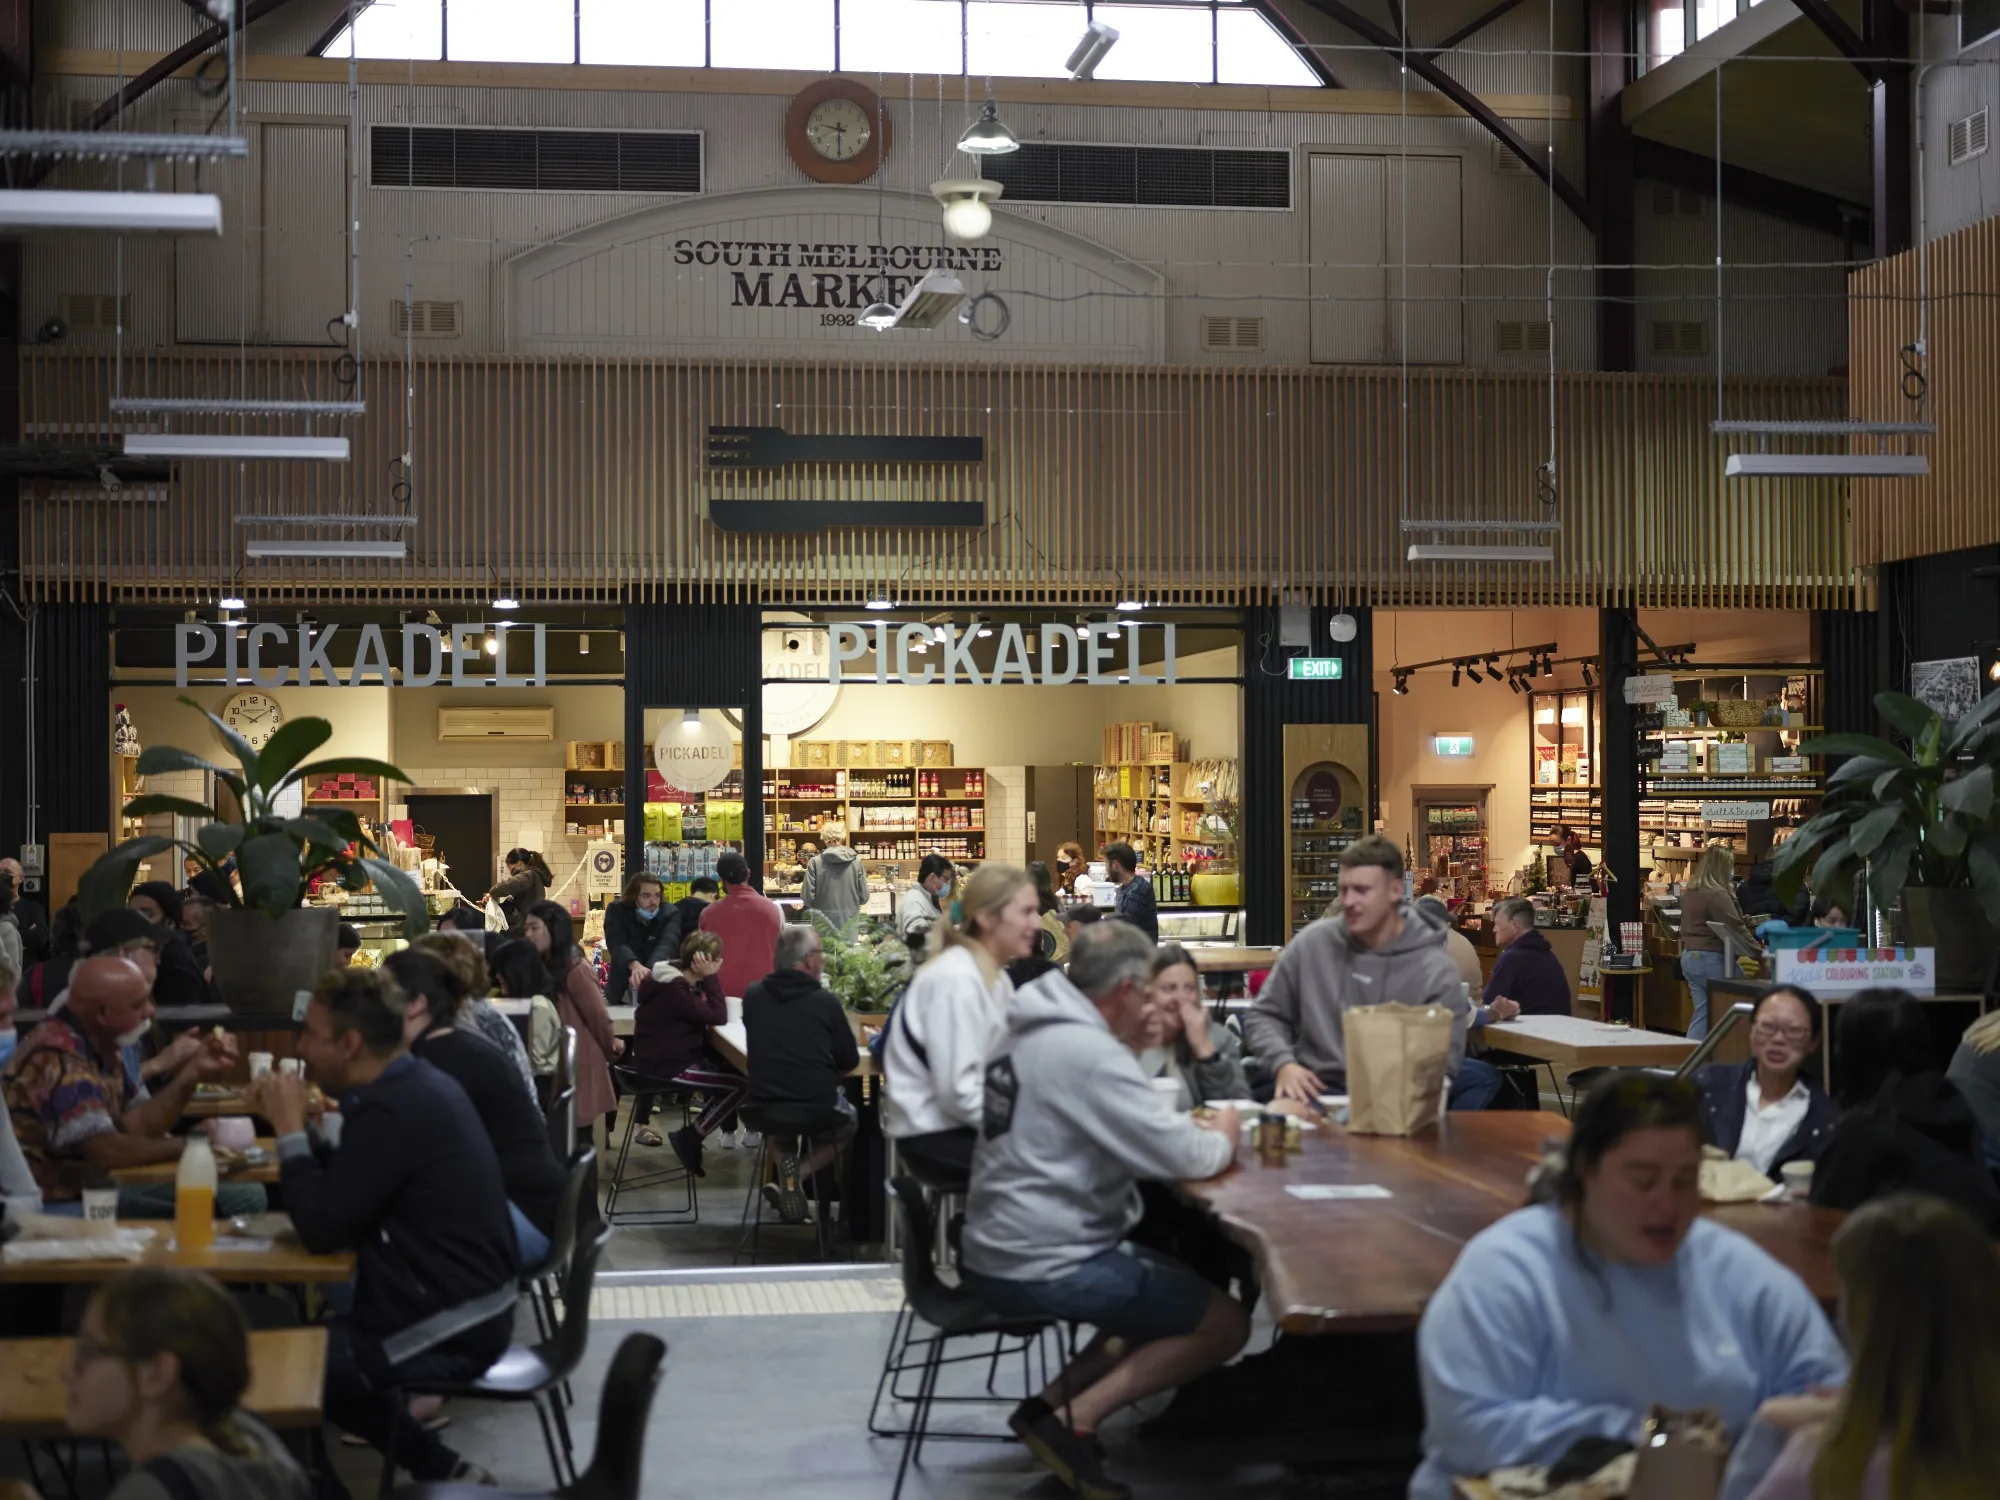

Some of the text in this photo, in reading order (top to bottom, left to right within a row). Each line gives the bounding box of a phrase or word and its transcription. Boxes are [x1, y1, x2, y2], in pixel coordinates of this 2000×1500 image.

[673, 240, 1003, 272] SOUTH MELBOURNE
[731, 271, 924, 309] MARKE
[819, 314, 856, 327] 1992
[175, 623, 546, 688] PICKADELI
[829, 623, 1176, 686] PICKADELI
[1303, 660, 1331, 677] EXIT
[240, 699, 246, 707] 11
[249, 696, 258, 704] 12
[263, 698, 267, 706] 1
[231, 707, 240, 715] 10
[269, 705, 275, 713] 2
[230, 717, 236, 725] 9
[270, 726, 276, 734] 4
[660, 746, 729, 760] PICKADELI
[1825, 966, 1869, 981] COLOURING
[1872, 966, 1904, 981] STATION
